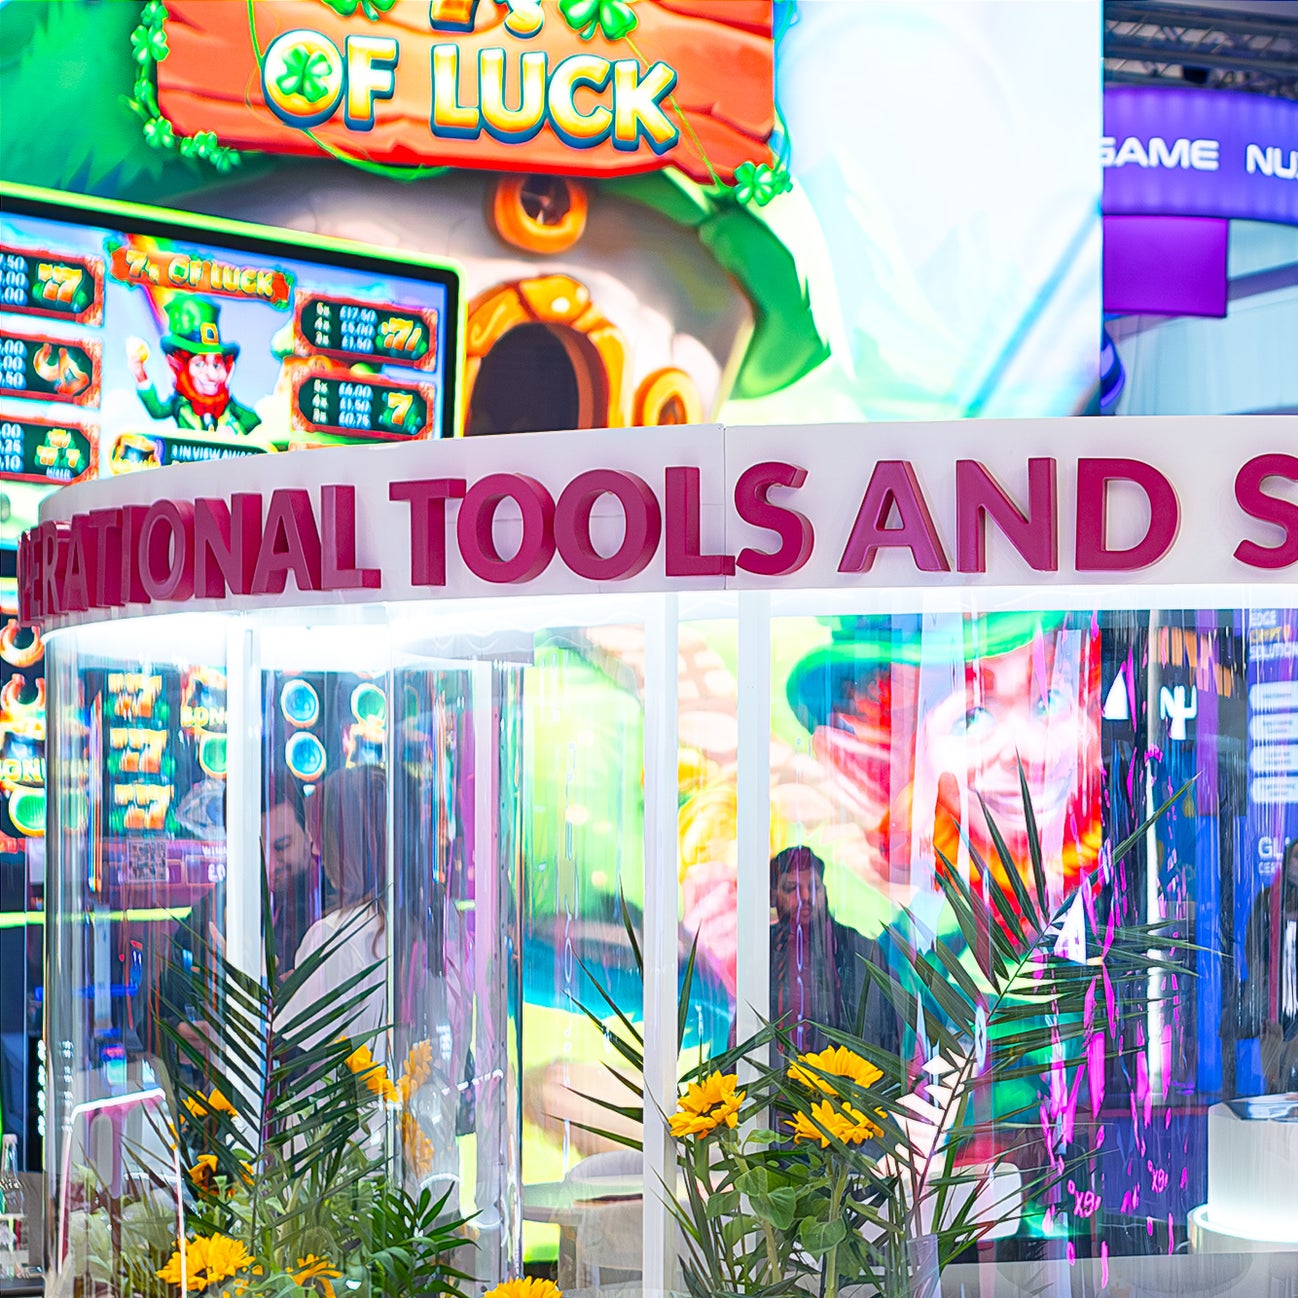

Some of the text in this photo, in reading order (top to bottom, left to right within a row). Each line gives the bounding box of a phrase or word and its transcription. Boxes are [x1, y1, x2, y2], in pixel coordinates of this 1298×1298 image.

[263, 29, 680, 157] OF LUCK
[210, 262, 275, 298] LUCK
[389, 461, 814, 586] TOOLS
[838, 458, 1182, 574] AND
